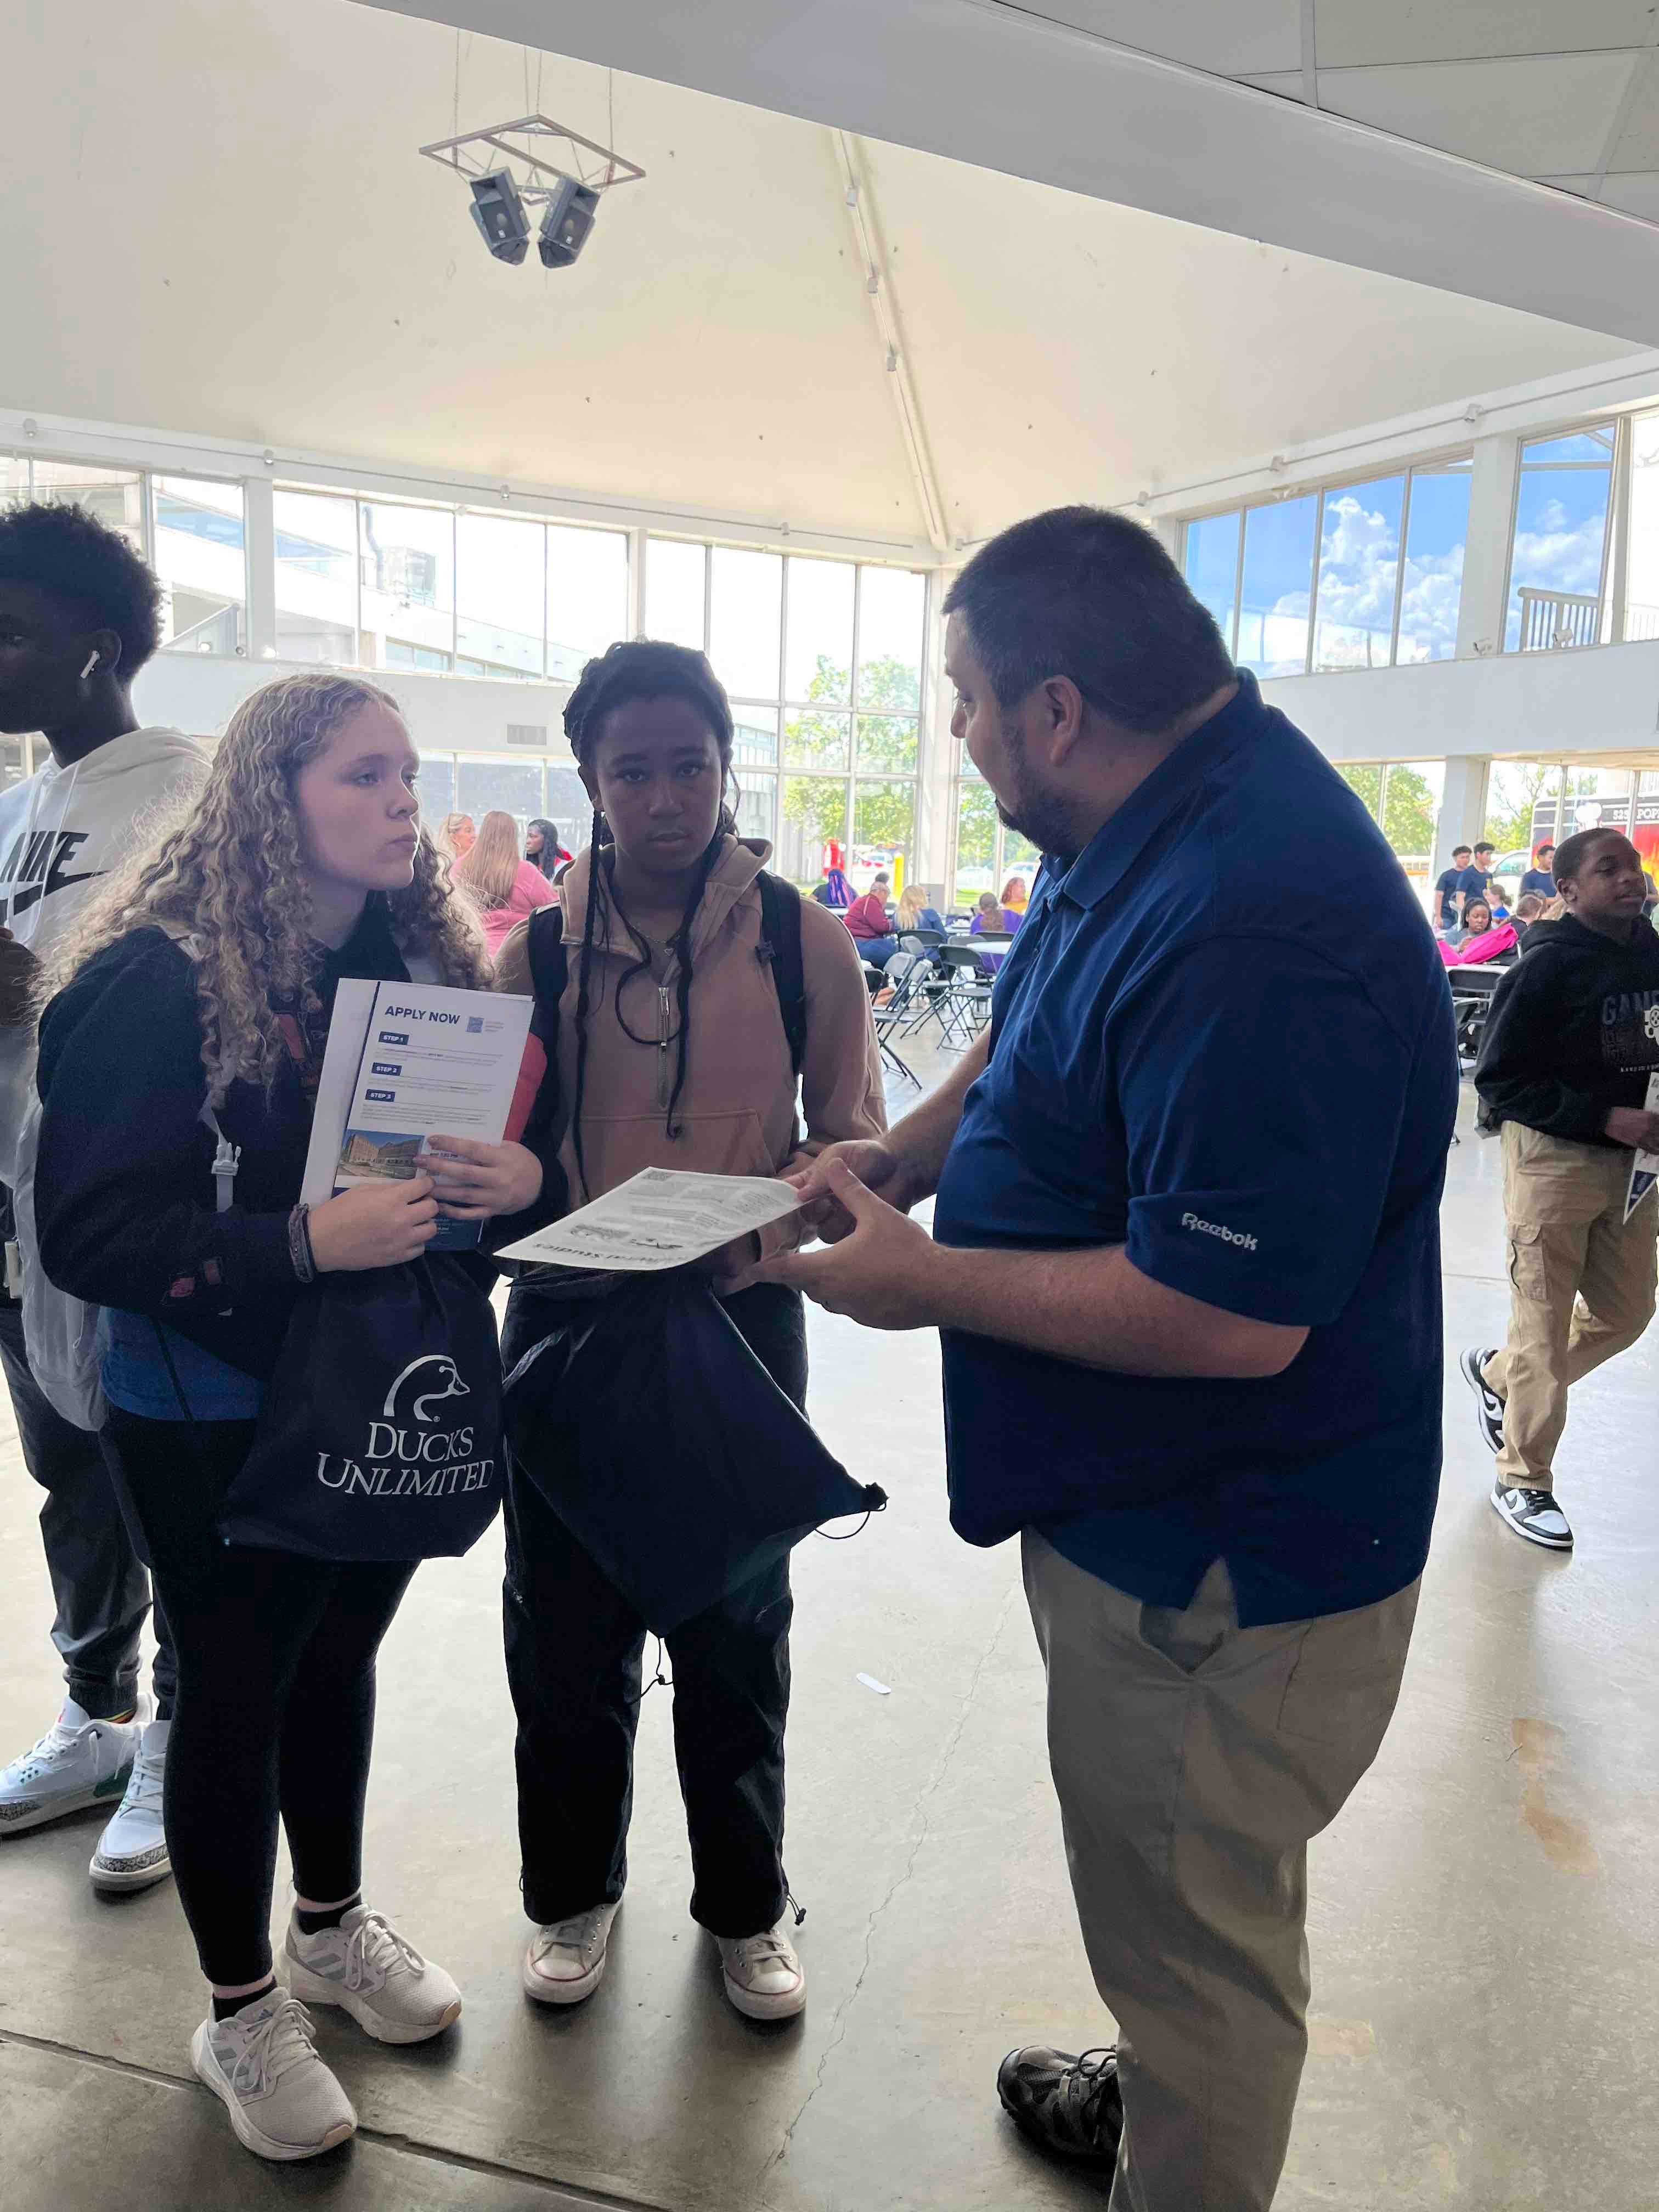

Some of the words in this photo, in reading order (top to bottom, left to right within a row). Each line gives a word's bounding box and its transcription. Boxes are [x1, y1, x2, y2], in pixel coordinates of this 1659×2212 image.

[385, 1005, 426, 1020] APPLY
[428, 1012, 461, 1024] NOW
[1181, 1212, 1258, 1251] Reebok
[365, 1422, 474, 1462] DUCKS
